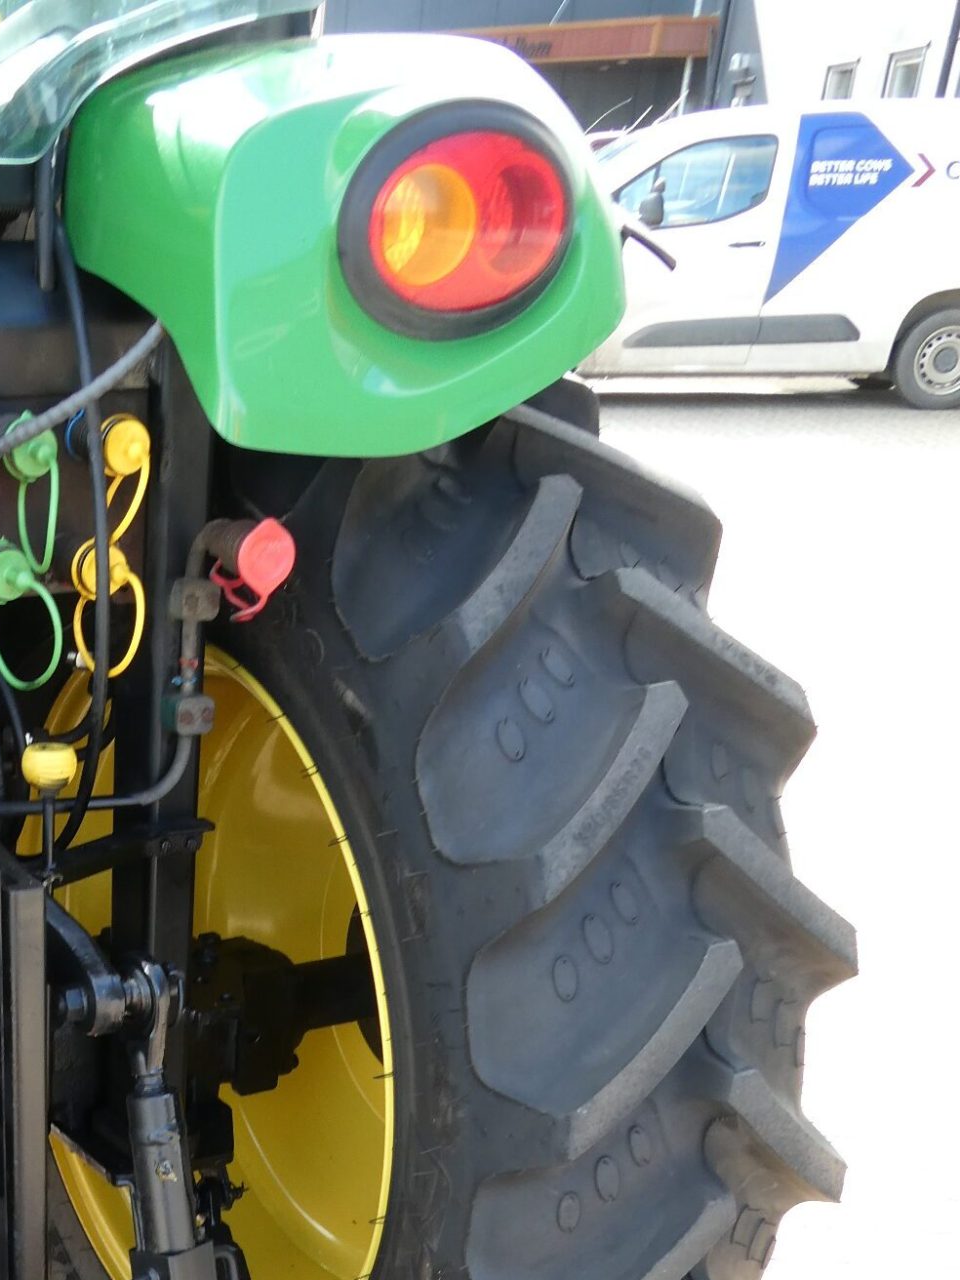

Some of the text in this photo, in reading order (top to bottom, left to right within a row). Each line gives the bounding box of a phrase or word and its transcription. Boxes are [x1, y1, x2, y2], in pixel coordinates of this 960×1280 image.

[810, 159, 893, 173] BETTER COWS
[808, 172, 879, 186] BETTER LIFE
